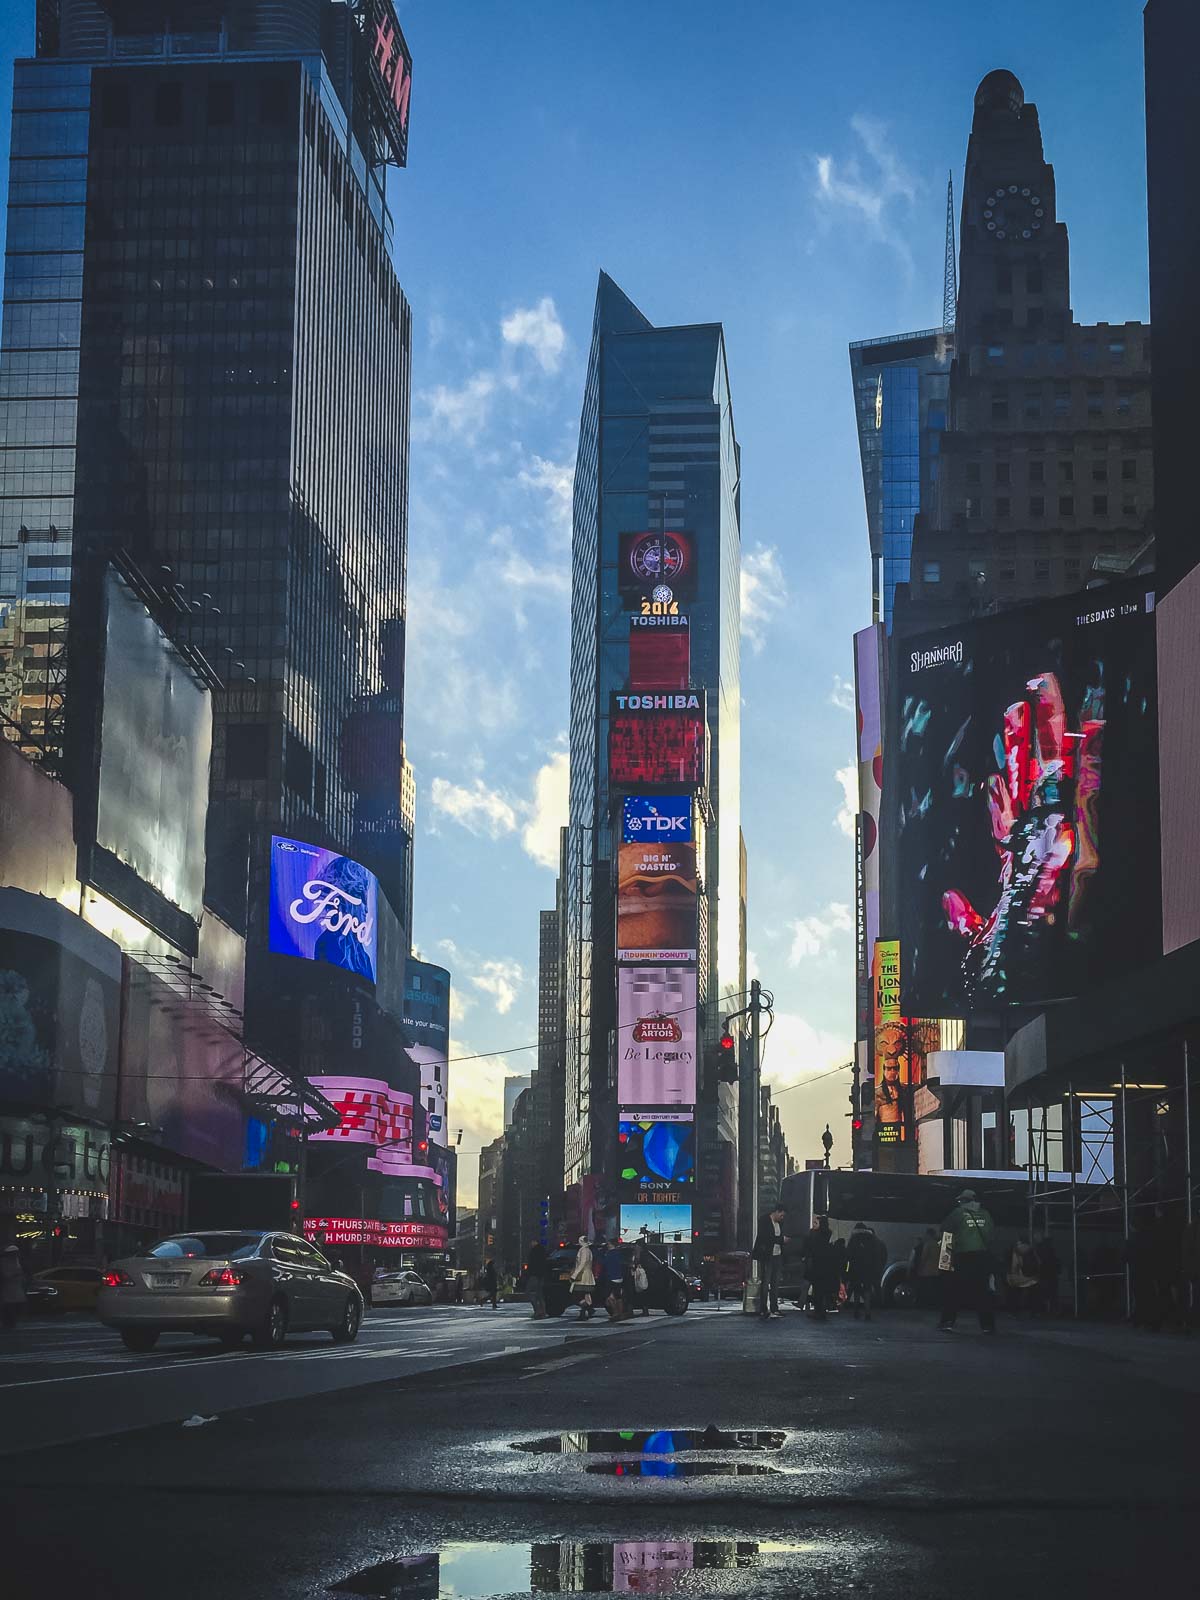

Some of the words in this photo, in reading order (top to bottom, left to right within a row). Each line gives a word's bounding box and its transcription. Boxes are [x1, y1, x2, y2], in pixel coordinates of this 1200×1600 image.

[374, 14, 411, 129] H&M
[641, 601, 679, 615] 2016
[631, 616, 688, 626] TOSHIBA
[1076, 607, 1115, 626] TUESDAYS
[910, 641, 963, 673] SHANNARA
[616, 695, 700, 709] TOSHIBA
[642, 816, 688, 831] TDK
[643, 854, 659, 862] BIG
[634, 863, 677, 871] TOASTED
[289, 879, 374, 947] Ford
[881, 965, 898, 974] THE
[352, 1002, 362, 1049] 1500
[624, 1047, 641, 1060] Be
[645, 1047, 693, 1064] Legacy
[637, 1192, 648, 1203] OR
[390, 1225, 409, 1233] TGIT
[335, 1233, 370, 1242] MURDER
[382, 1236, 423, 1246] ANATOMY
